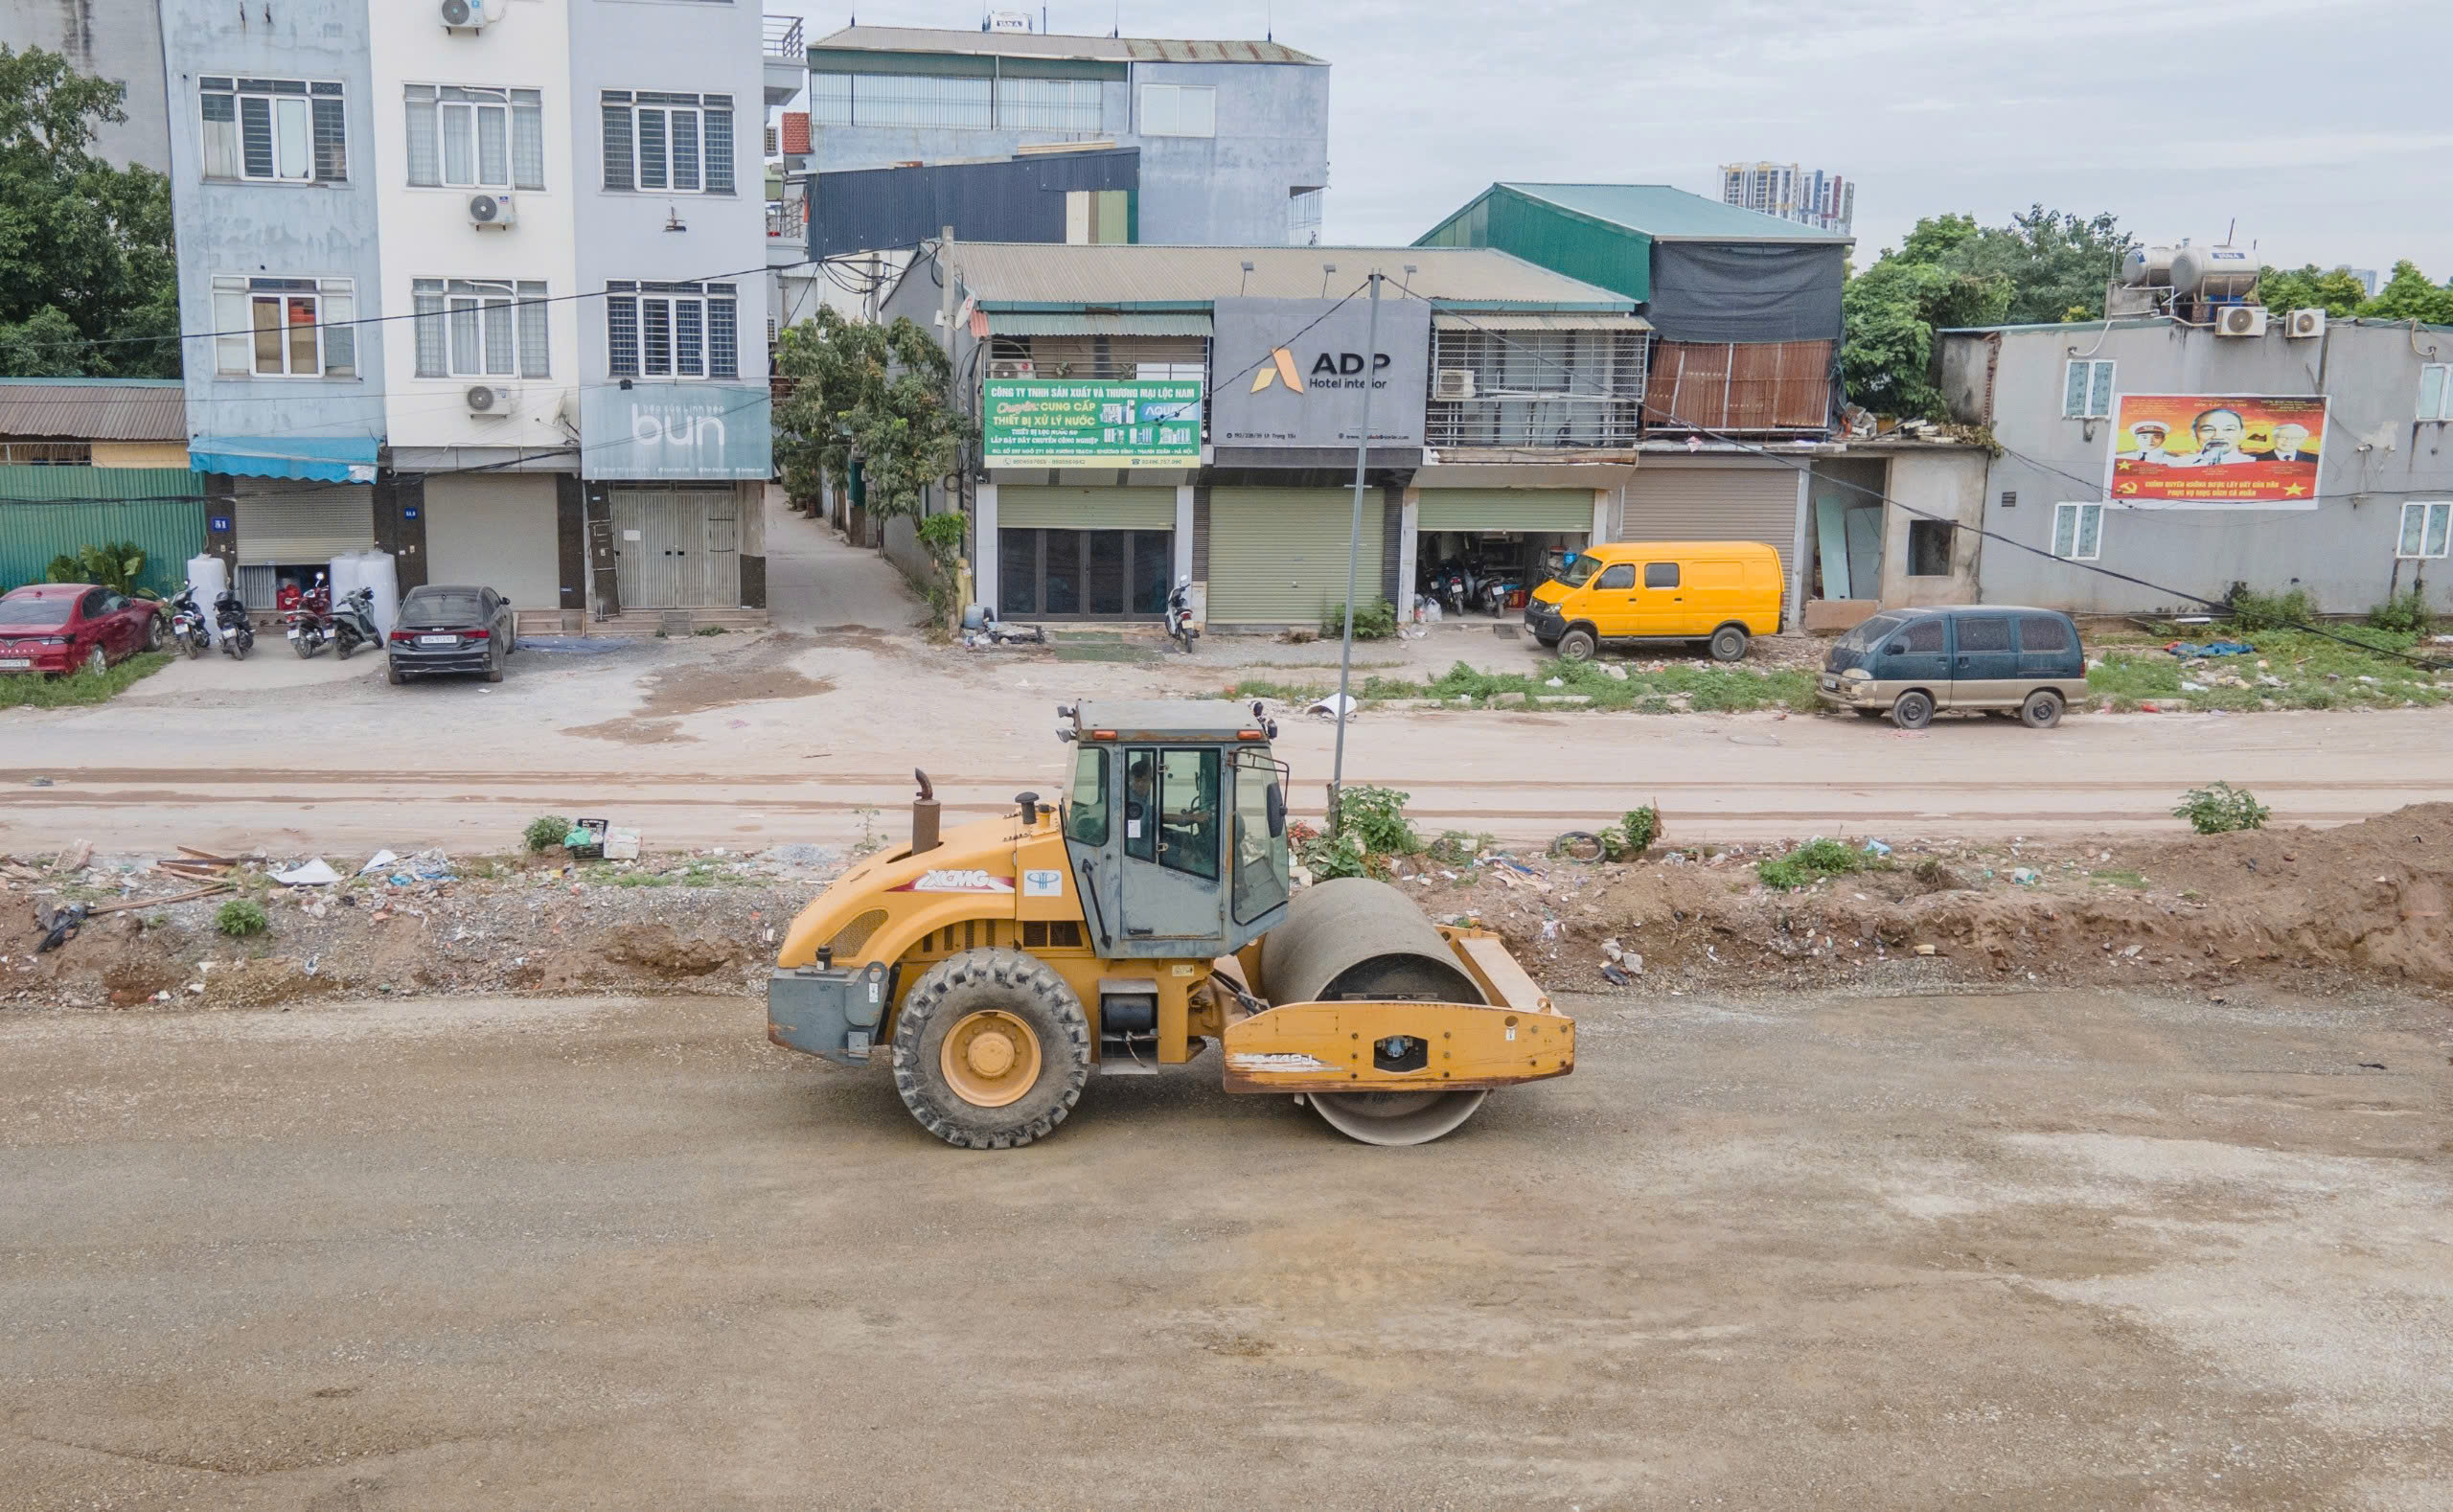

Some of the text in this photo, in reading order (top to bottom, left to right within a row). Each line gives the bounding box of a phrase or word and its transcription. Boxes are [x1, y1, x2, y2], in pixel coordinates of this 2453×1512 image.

[1311, 353, 1391, 375] ADP
[1309, 378, 1387, 389] Hotel inteior
[991, 385, 1015, 398] CÔNG
[1016, 387, 1026, 398] TY
[1026, 387, 1049, 398] TNHH
[1070, 385, 1091, 398] XUẤT
[1093, 386, 1104, 398] VÀ
[1139, 388, 1157, 401] MẠI
[1158, 387, 1174, 401] LỘC
[1175, 388, 1195, 398] NAM
[1040, 402, 1071, 412] CUNG
[1073, 400, 1096, 412] CẤP
[632, 403, 725, 445] bun
[993, 414, 1020, 425] THIẾT
[1021, 416, 1032, 427] BỊ
[1051, 414, 1063, 425] LÝ
[923, 869, 991, 887] XCMG
